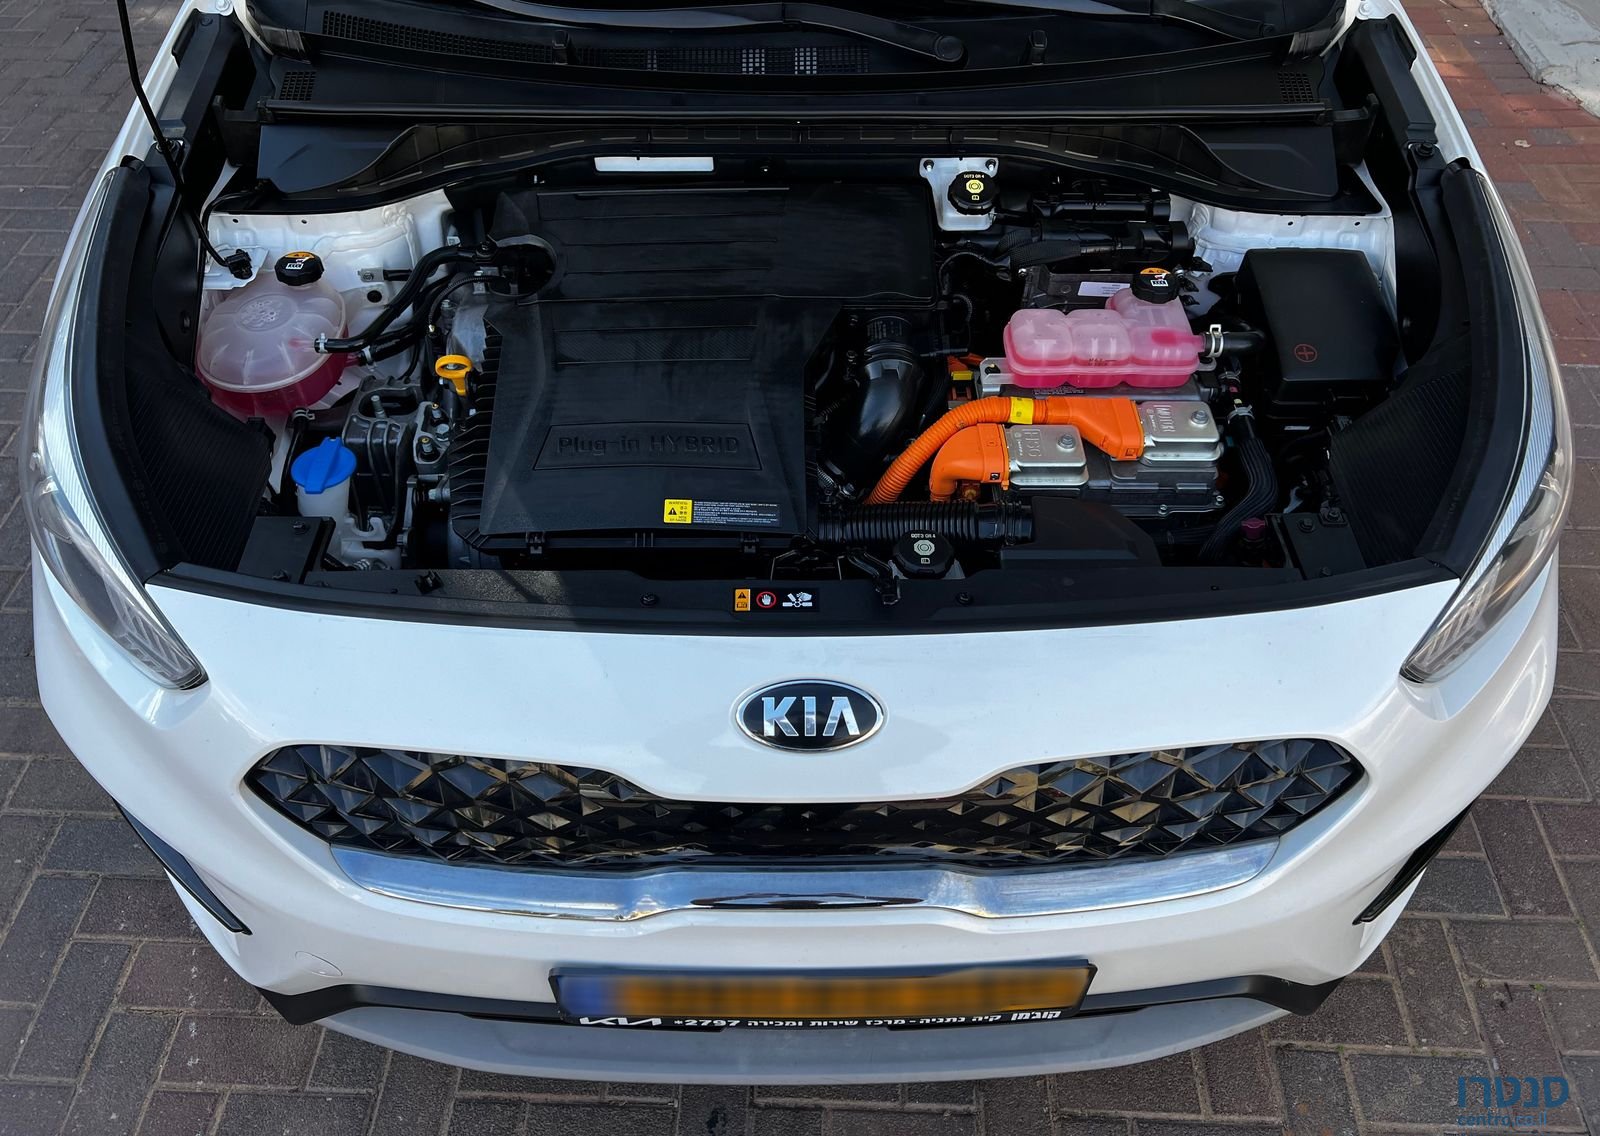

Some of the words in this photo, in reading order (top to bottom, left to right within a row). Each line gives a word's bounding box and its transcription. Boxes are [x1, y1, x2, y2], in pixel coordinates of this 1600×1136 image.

[557, 435, 640, 456] Plug-in
[649, 435, 740, 455] HYBRID
[761, 696, 861, 737] KIA
[972, 1014, 1002, 1022] קיה
